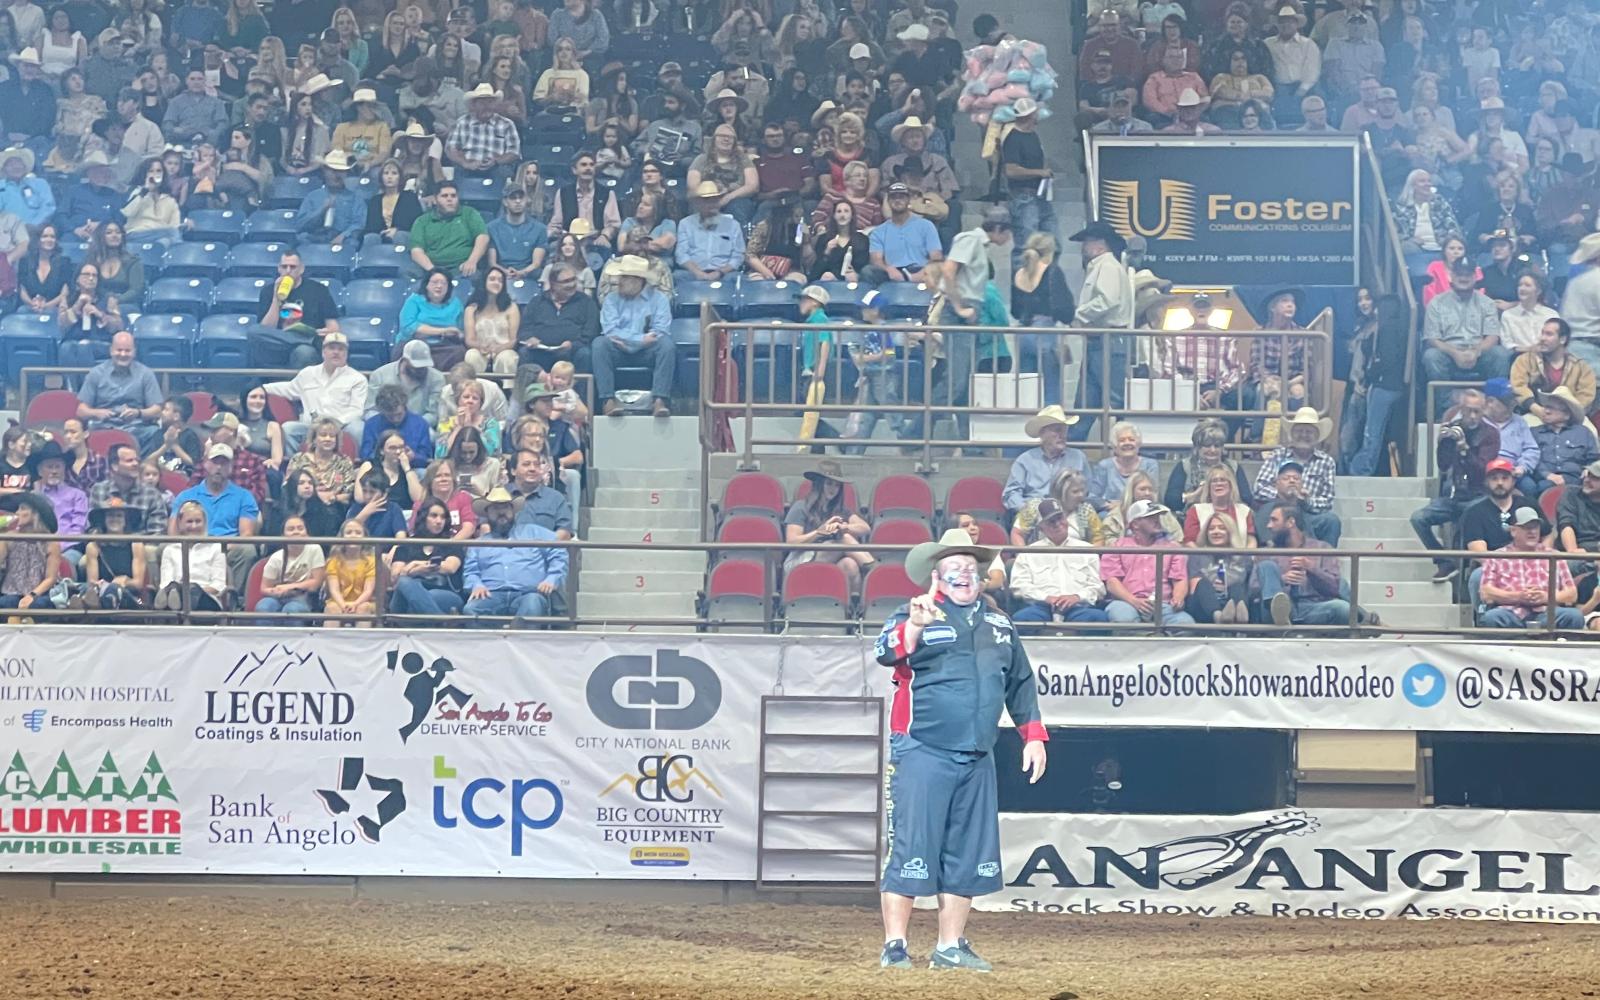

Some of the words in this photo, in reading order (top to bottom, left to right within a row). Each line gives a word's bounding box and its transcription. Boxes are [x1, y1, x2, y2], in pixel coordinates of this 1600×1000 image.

[1208, 194, 1352, 221] Foster
[1209, 223, 1299, 232] COMMUNICATIONS
[1302, 223, 1352, 232] COLISEUM
[1205, 254, 1219, 262] FM
[651, 493, 660, 504] 5
[1366, 501, 1375, 512] 5
[642, 532, 652, 542] 4
[635, 575, 645, 587] 3
[1385, 585, 1394, 597] 3
[1037, 663, 1395, 707] SanAngeloStockShowandRodeo
[91, 687, 174, 702] HOSPITAL
[205, 691, 355, 725] LEGEND
[435, 701, 461, 720] San
[515, 701, 536, 721] To
[532, 702, 553, 722] Go
[3, 716, 16, 726] of
[51, 716, 125, 728] Encompass
[130, 717, 173, 727] Health
[195, 727, 264, 743] Coatings
[270, 728, 280, 740] &
[286, 728, 362, 742] Insulation
[420, 723, 486, 735] DELIVERY
[491, 724, 547, 736] SERVICE
[575, 737, 607, 748] CITY
[615, 738, 684, 749] NATIONAL
[692, 739, 731, 750] BANK
[5, 771, 163, 794] CITY
[209, 795, 275, 817] Bank
[278, 815, 291, 824] of
[597, 807, 627, 822] BIG
[634, 808, 723, 824] COUNTRY
[208, 822, 252, 844] San
[265, 822, 356, 851] Angelo
[604, 829, 715, 843] EQUIPMENT
[1010, 898, 1103, 914] Stock
[1118, 900, 1216, 915] Show
[1230, 902, 1254, 916] &
[1272, 903, 1386, 919] Rodeo
